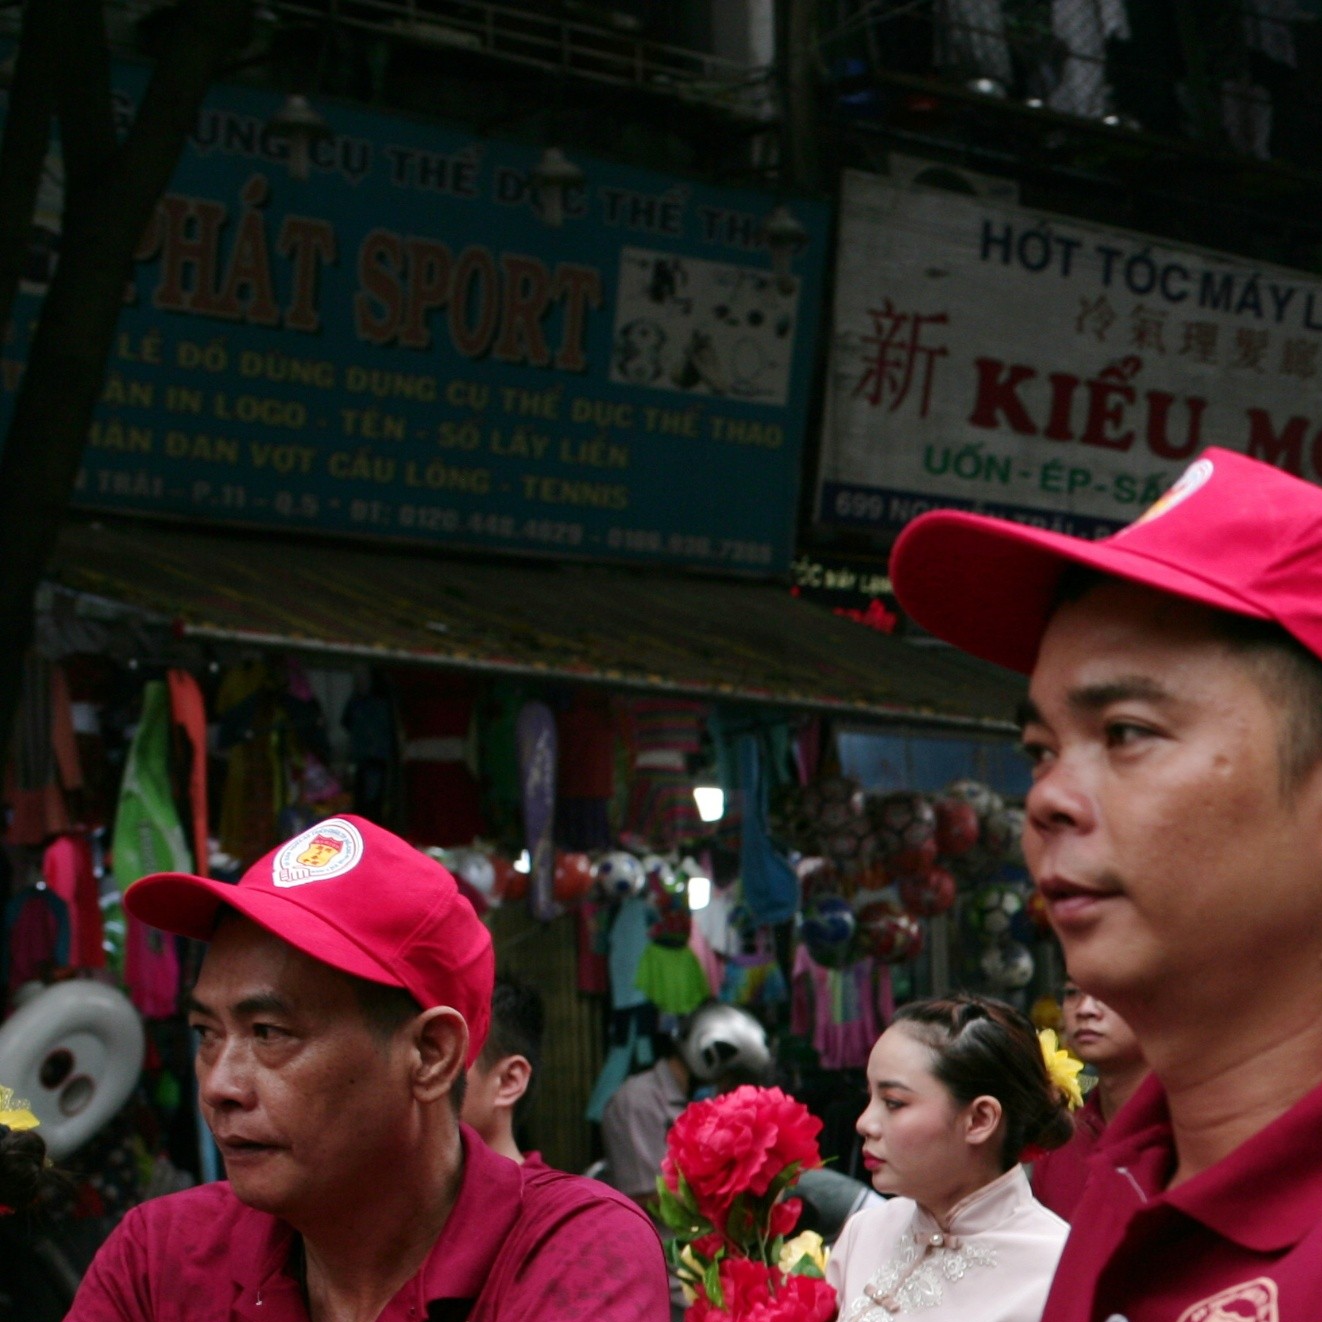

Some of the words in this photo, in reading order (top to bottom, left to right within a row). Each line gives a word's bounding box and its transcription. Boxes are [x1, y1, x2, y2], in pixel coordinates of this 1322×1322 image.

[353, 226, 603, 372] SPORT
[1095, 242, 1190, 303] TÓC
[1198, 271, 1296, 324] MÁY
[853, 295, 949, 420] 新
[165, 384, 204, 416] IN
[213, 390, 308, 430] LOGO
[966, 353, 1209, 462] KIỂU
[520, 473, 631, 512] TENNIS
